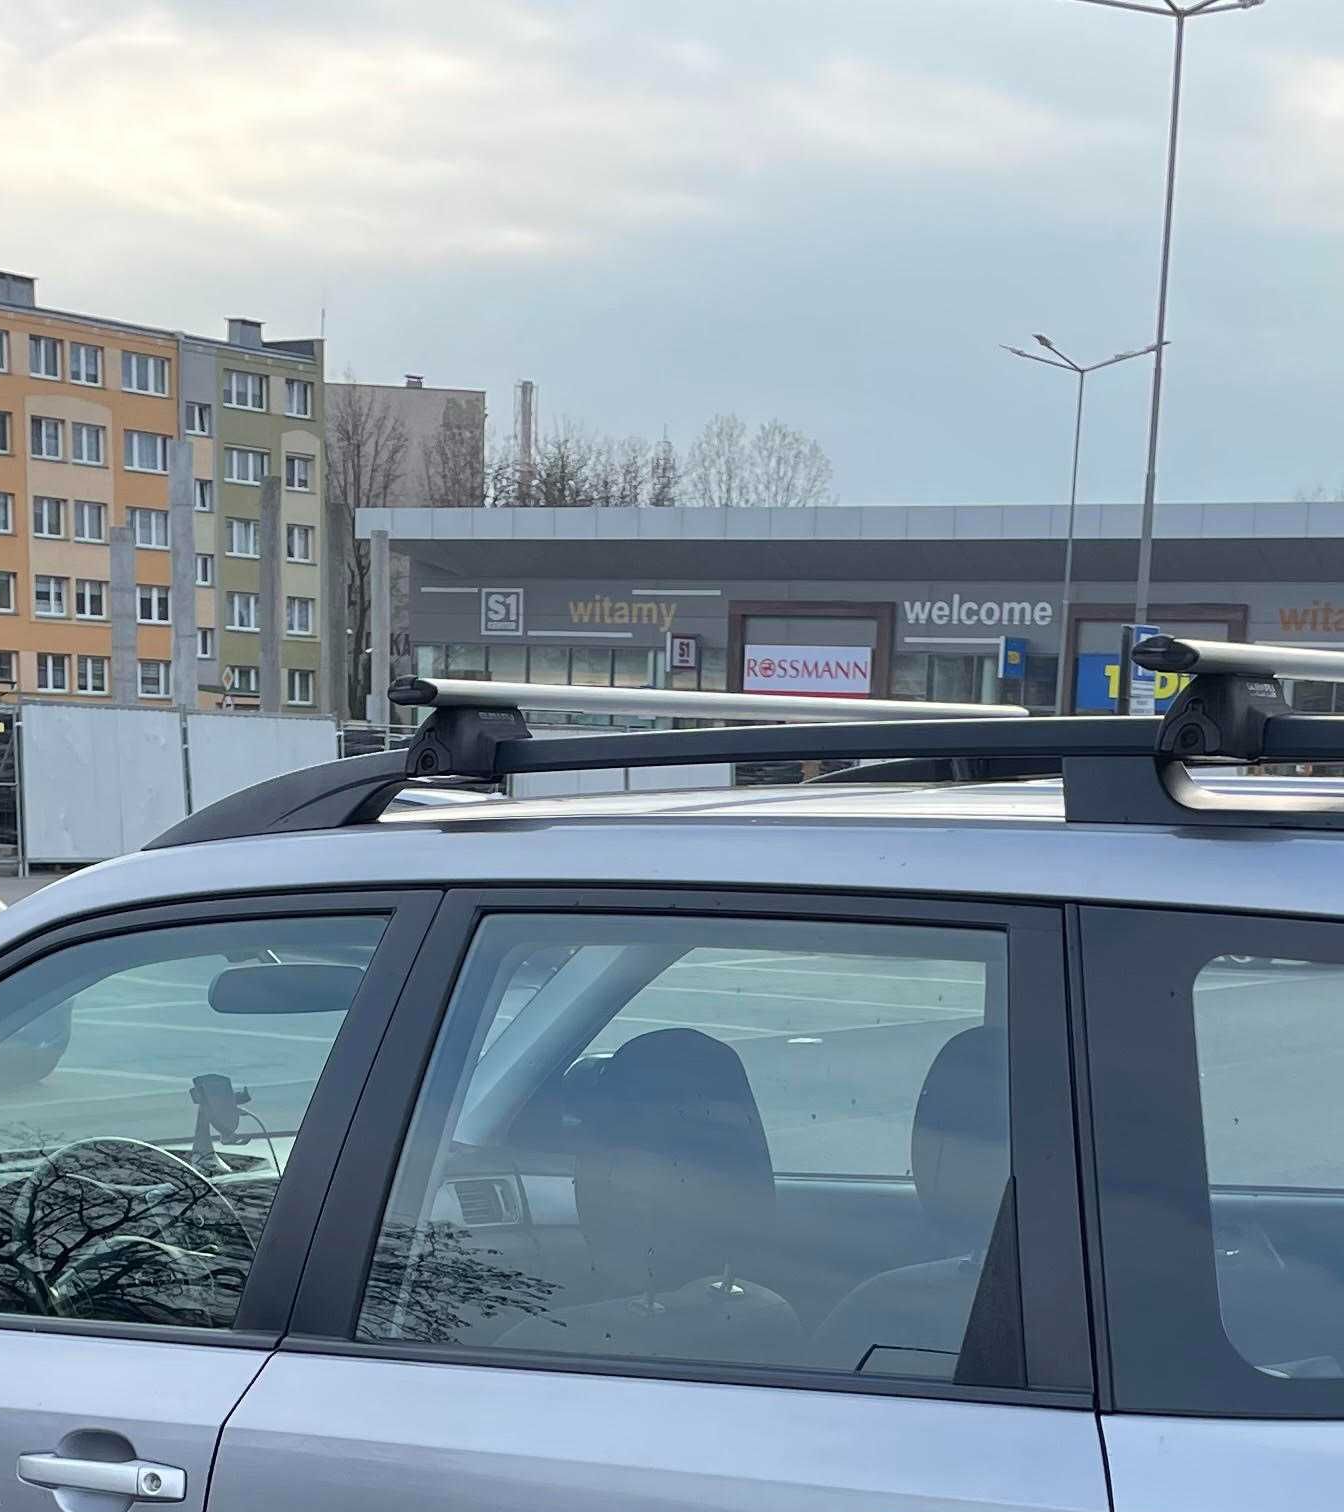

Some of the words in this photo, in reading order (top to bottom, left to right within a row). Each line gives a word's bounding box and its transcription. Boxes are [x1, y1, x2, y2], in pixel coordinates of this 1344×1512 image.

[487, 594, 518, 620] S1
[569, 595, 677, 632] witamy
[904, 594, 1053, 625] welcome
[746, 658, 869, 679] ROSSMANN
